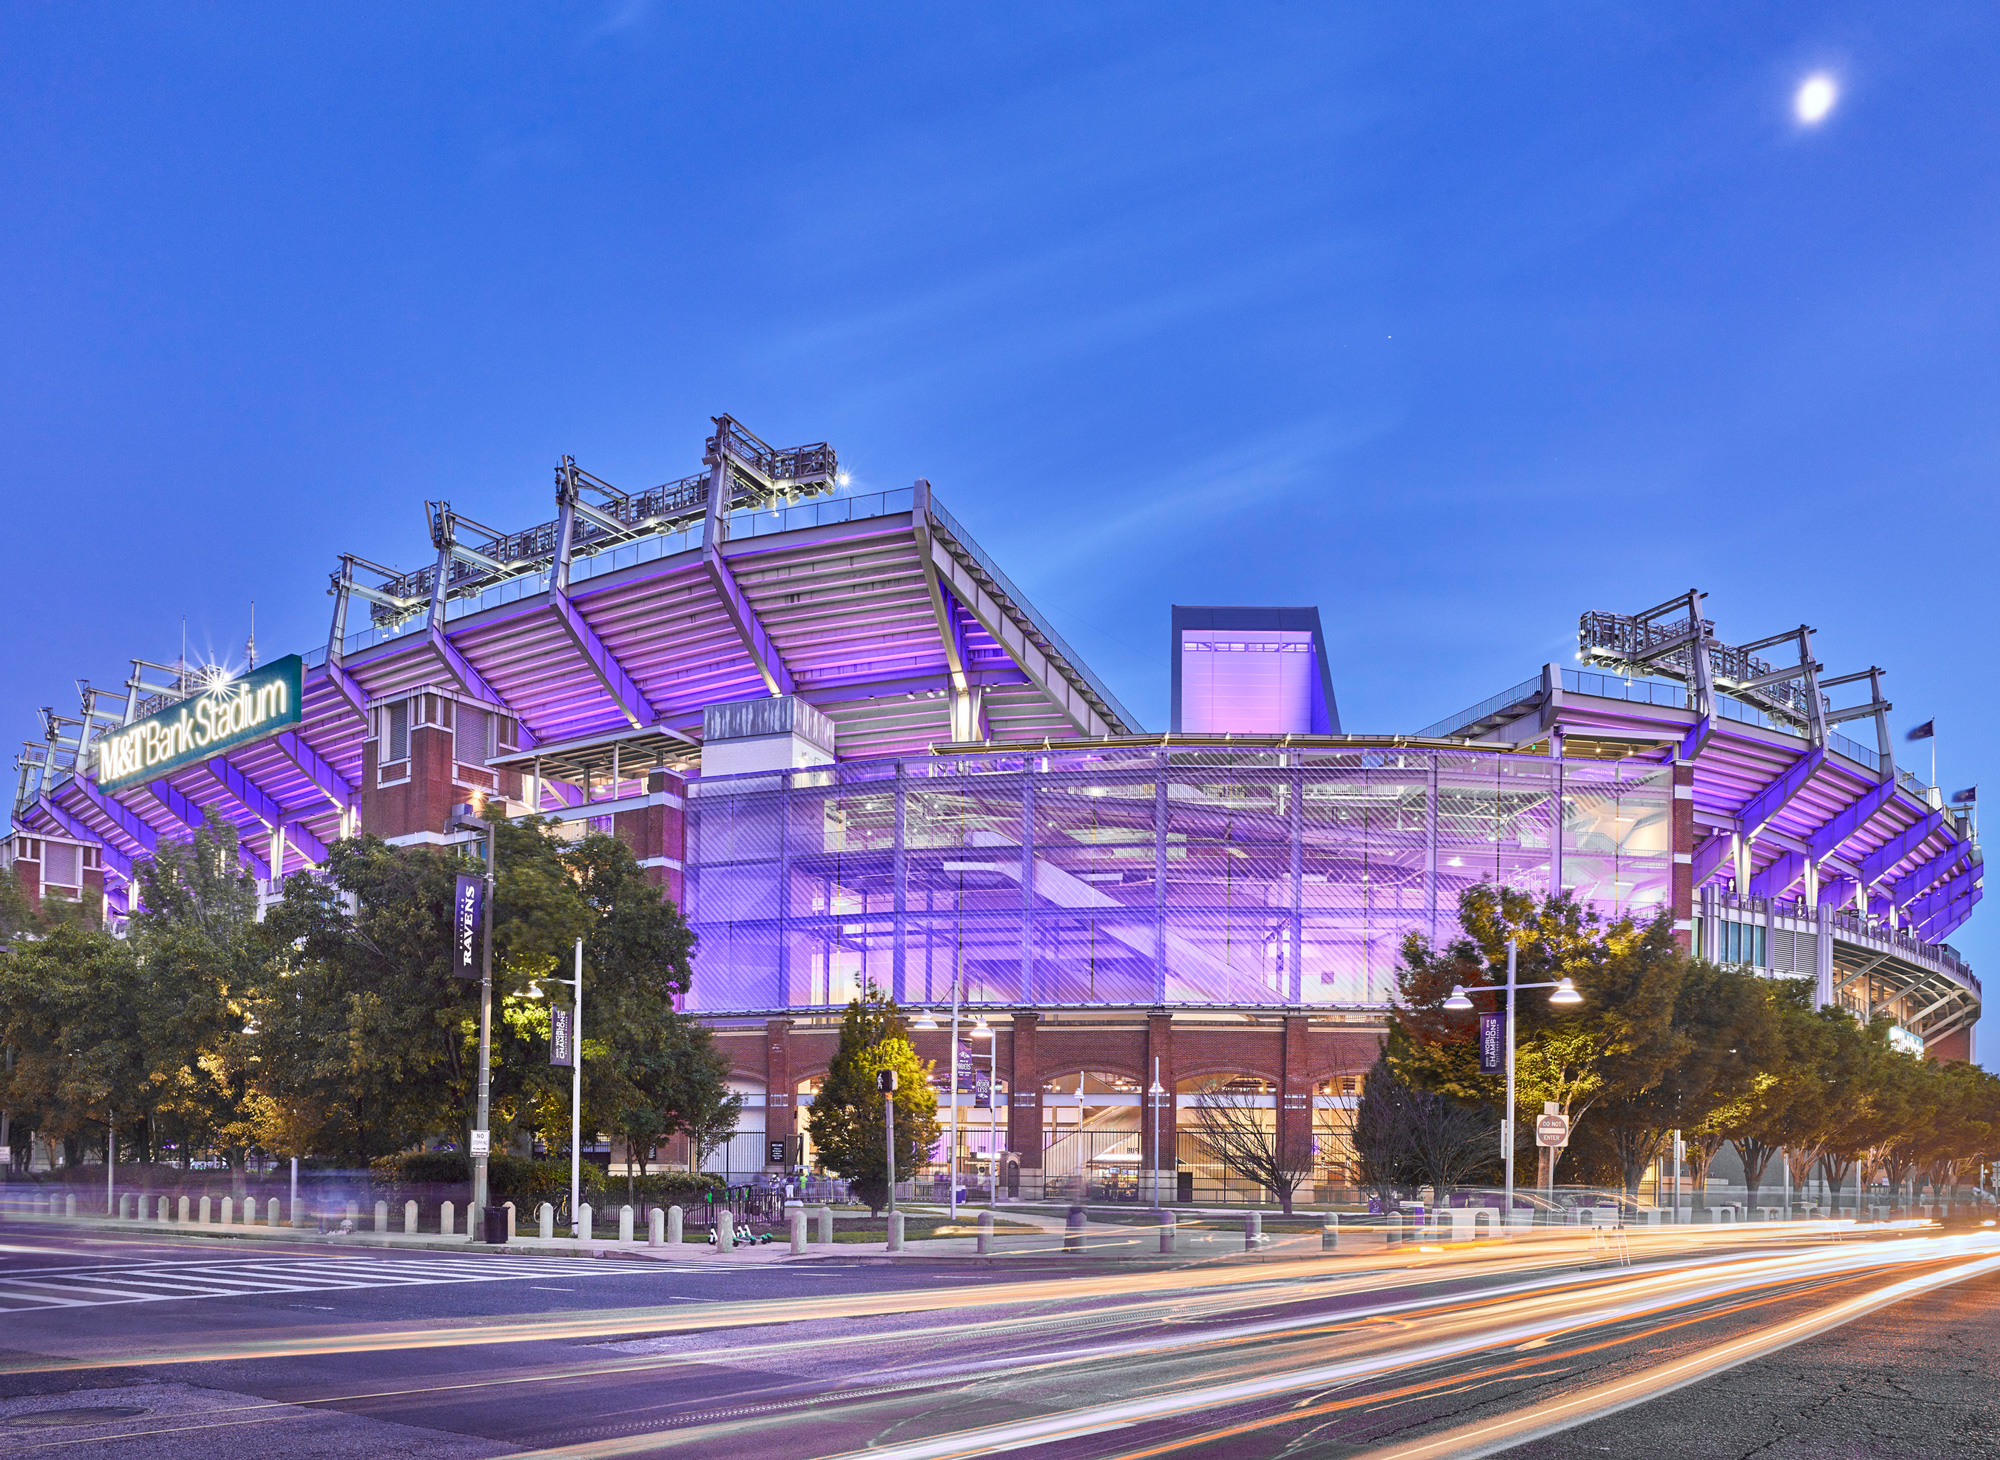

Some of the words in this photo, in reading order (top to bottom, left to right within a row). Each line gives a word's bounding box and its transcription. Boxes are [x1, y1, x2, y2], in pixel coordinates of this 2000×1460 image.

[99, 725, 147, 784] M&T
[146, 708, 195, 766] Bank
[195, 679, 287, 746] Stadium
[463, 885, 475, 967] RAVENS
[1489, 1018, 1497, 1068] CHAMPIONS
